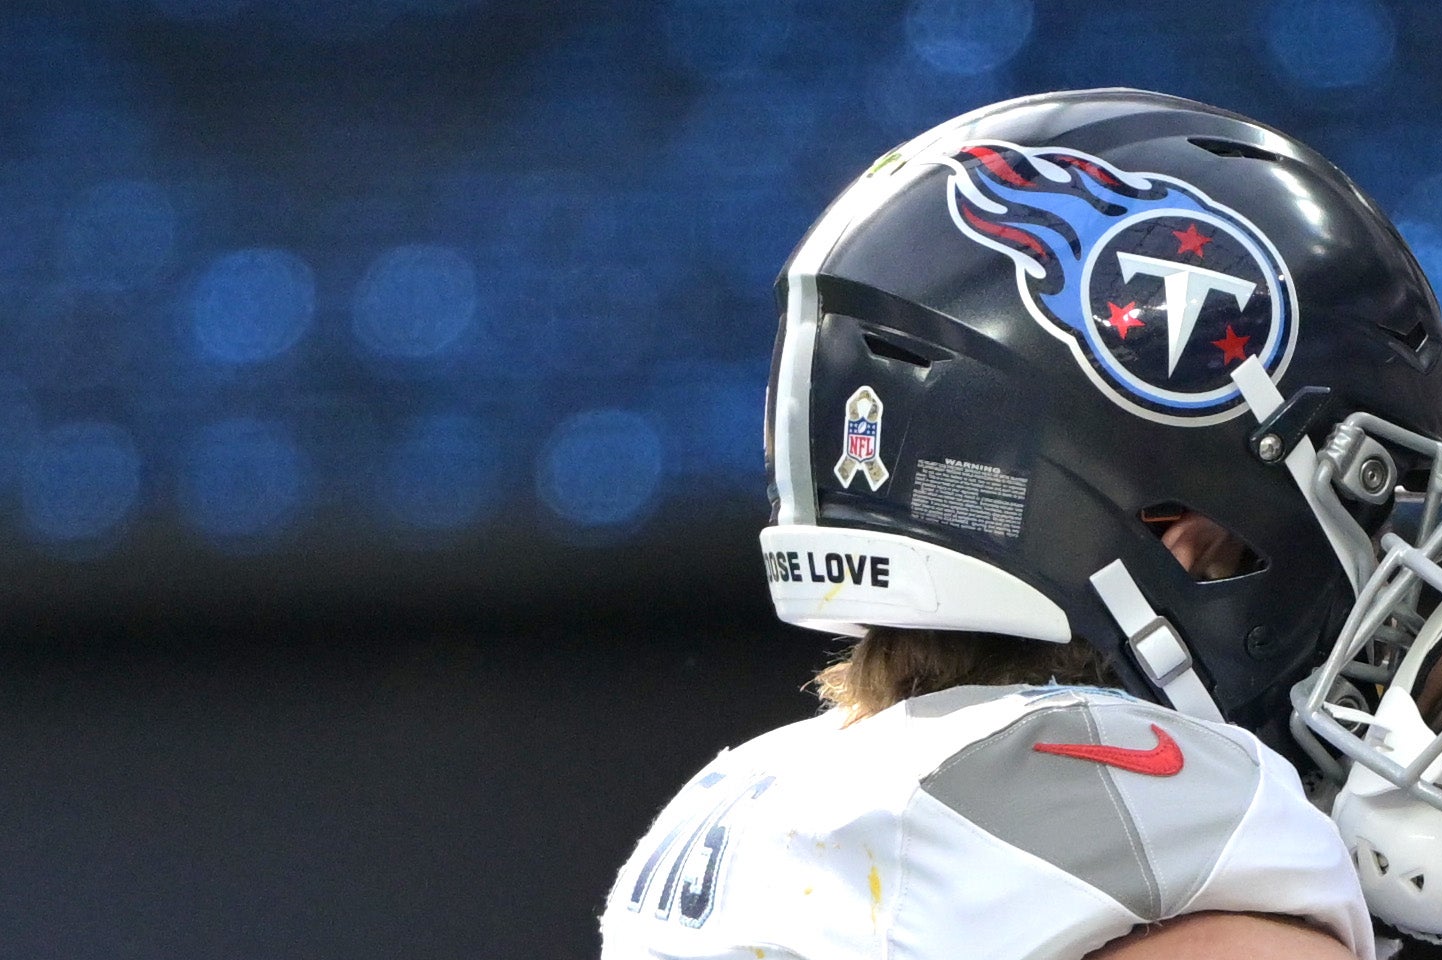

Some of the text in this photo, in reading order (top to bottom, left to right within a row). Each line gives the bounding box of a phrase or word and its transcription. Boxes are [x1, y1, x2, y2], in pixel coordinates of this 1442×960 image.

[849, 435, 875, 459] NFL
[945, 458, 1001, 474] WARNING
[807, 551, 890, 589] LOVE
